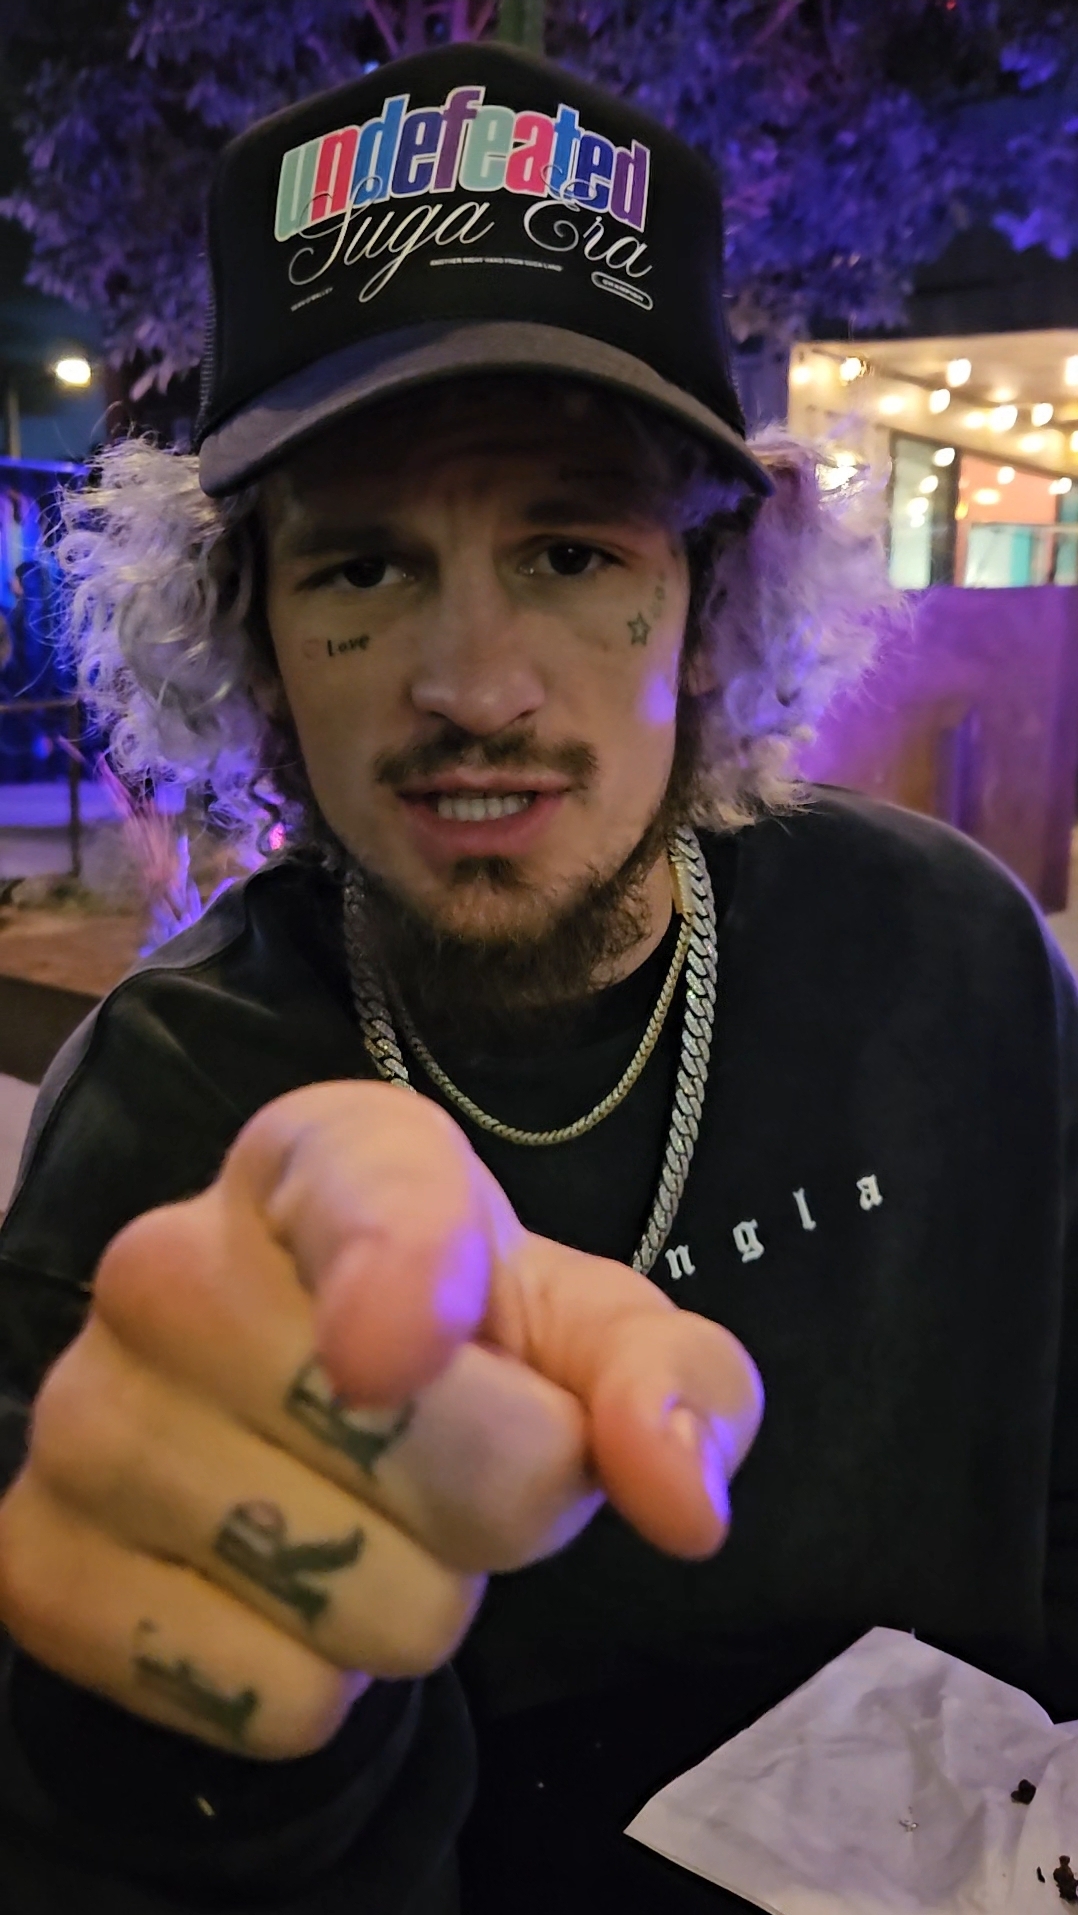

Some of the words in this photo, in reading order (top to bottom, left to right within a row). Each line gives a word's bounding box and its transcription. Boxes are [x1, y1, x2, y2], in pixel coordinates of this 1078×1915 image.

[274, 85, 651, 242] undefeated
[289, 175, 494, 303] Suga
[523, 164, 653, 278] Era
